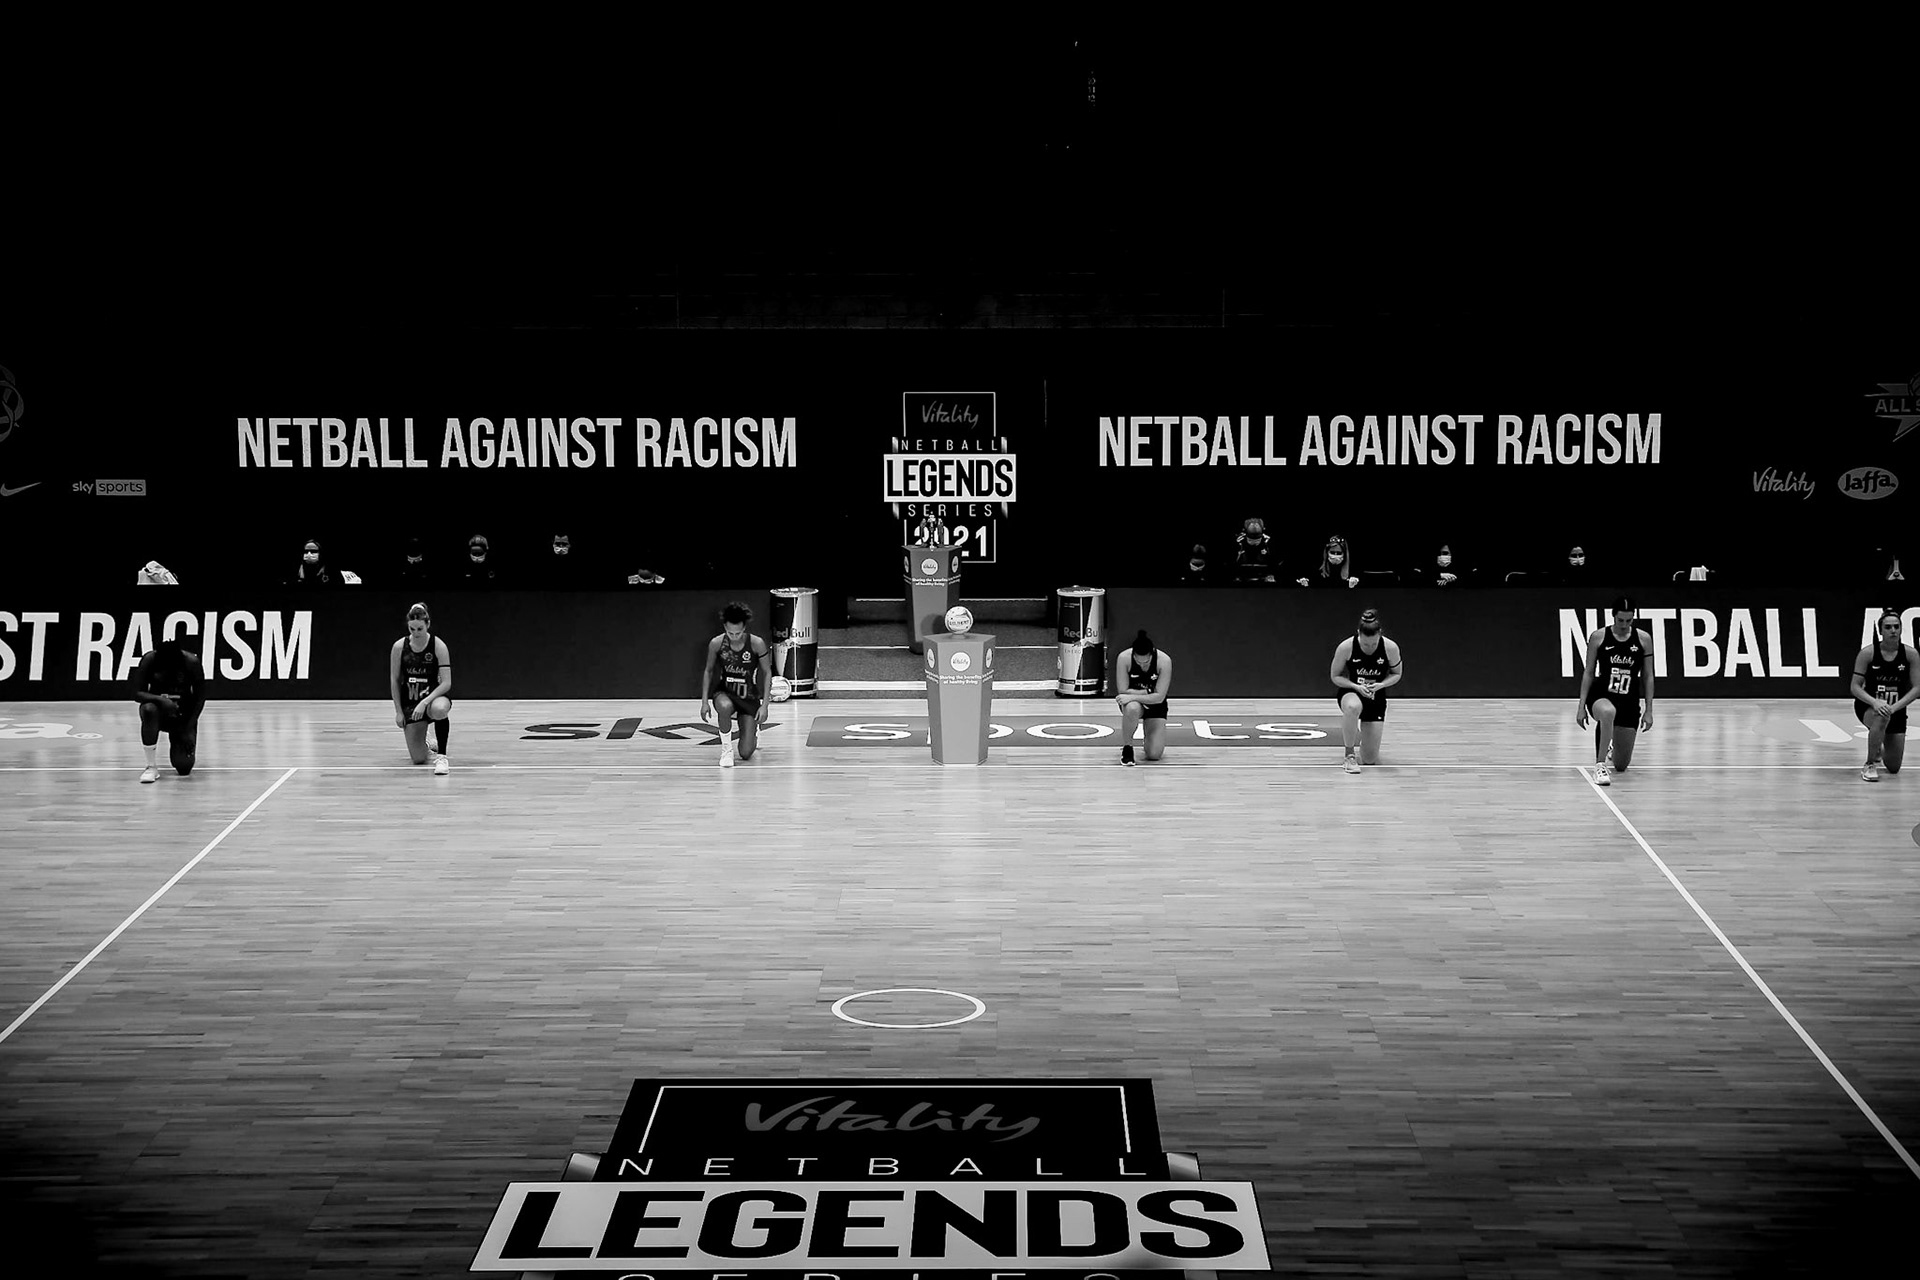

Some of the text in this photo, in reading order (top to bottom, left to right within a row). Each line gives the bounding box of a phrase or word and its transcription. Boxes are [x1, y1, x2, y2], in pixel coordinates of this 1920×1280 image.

[922, 401, 979, 429] Vitality
[1874, 399, 1912, 413] ALL
[237, 417, 797, 468] NETBALL AGAINST RACISM
[901, 439, 998, 451] NETBALL
[1099, 413, 1662, 467] NETBALL AGAINST RACISM
[72, 481, 143, 495] sky sports
[886, 459, 1013, 497] LEGENDS
[1753, 467, 1816, 500] Vitality
[908, 504, 993, 517] SERIES
[1559, 607, 1840, 678] NTBALL
[745, 1095, 1041, 1142] Vitality
[618, 1157, 1147, 1176] NETBALL
[499, 1189, 1245, 1260] LEGENDS
